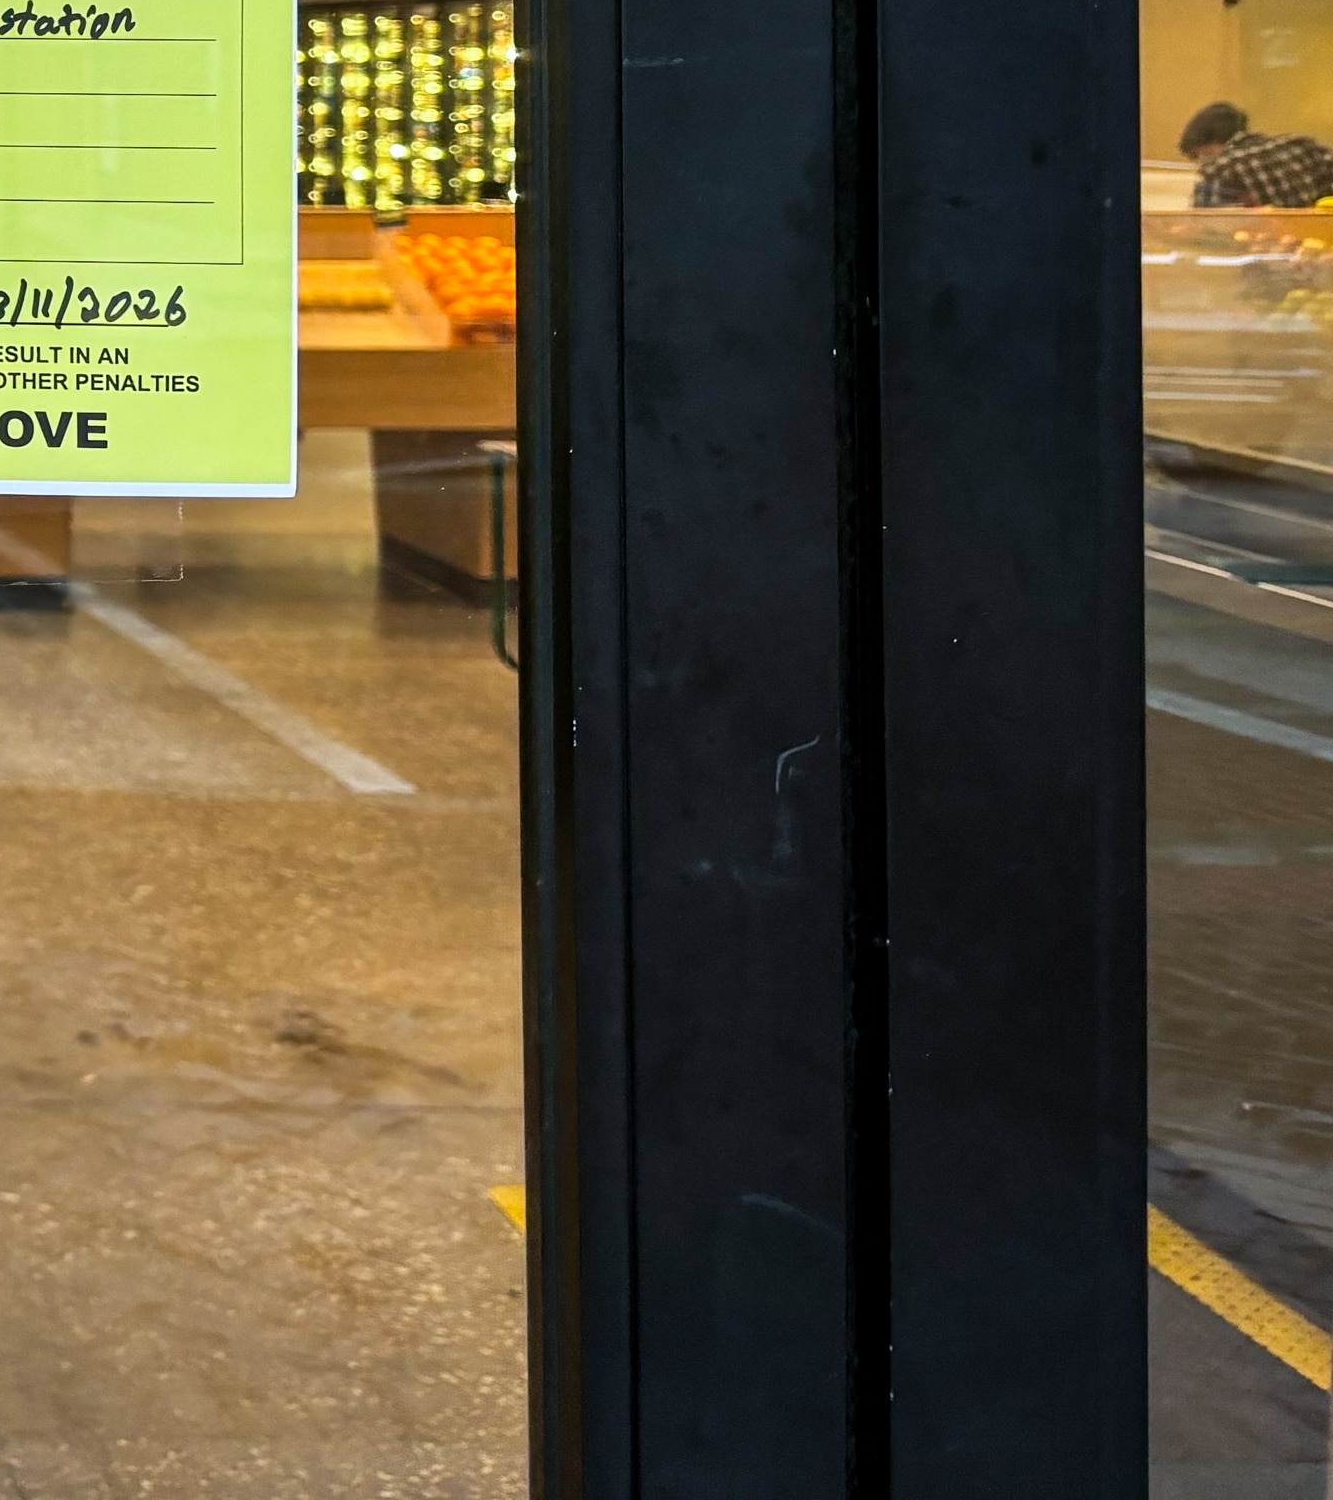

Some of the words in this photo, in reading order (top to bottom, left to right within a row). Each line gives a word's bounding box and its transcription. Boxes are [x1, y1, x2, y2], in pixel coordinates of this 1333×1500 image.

[69, 347, 90, 364] IN
[97, 347, 129, 365] AN
[76, 373, 200, 393] PENALTIES
